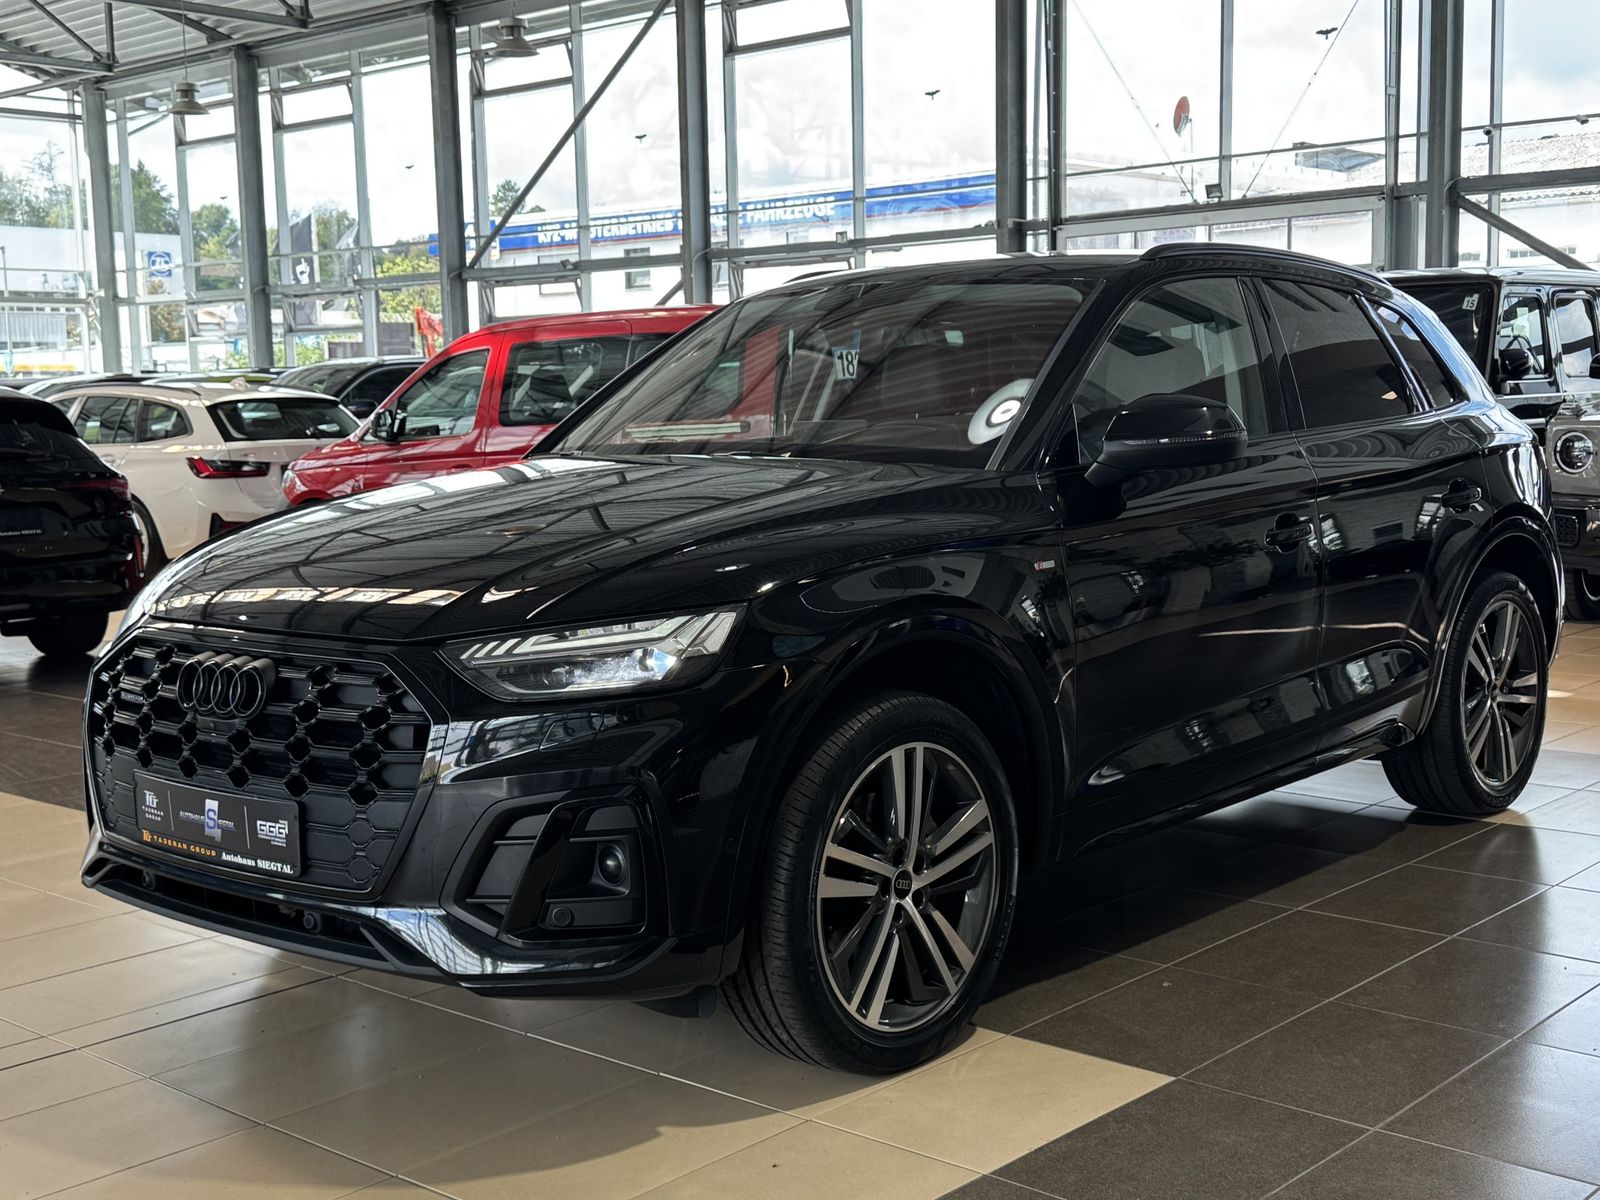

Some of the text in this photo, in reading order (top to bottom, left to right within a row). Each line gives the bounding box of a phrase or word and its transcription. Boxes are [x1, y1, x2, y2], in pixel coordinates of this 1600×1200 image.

[537, 212, 674, 243] KFZ-MSTERBETRIEB
[746, 196, 836, 223] FAHRZEUGE
[1466, 299, 1476, 309] 15
[257, 820, 288, 838] GGG
[190, 844, 216, 856] GROUP
[221, 851, 294, 875] Autohaus SIEGTAL
